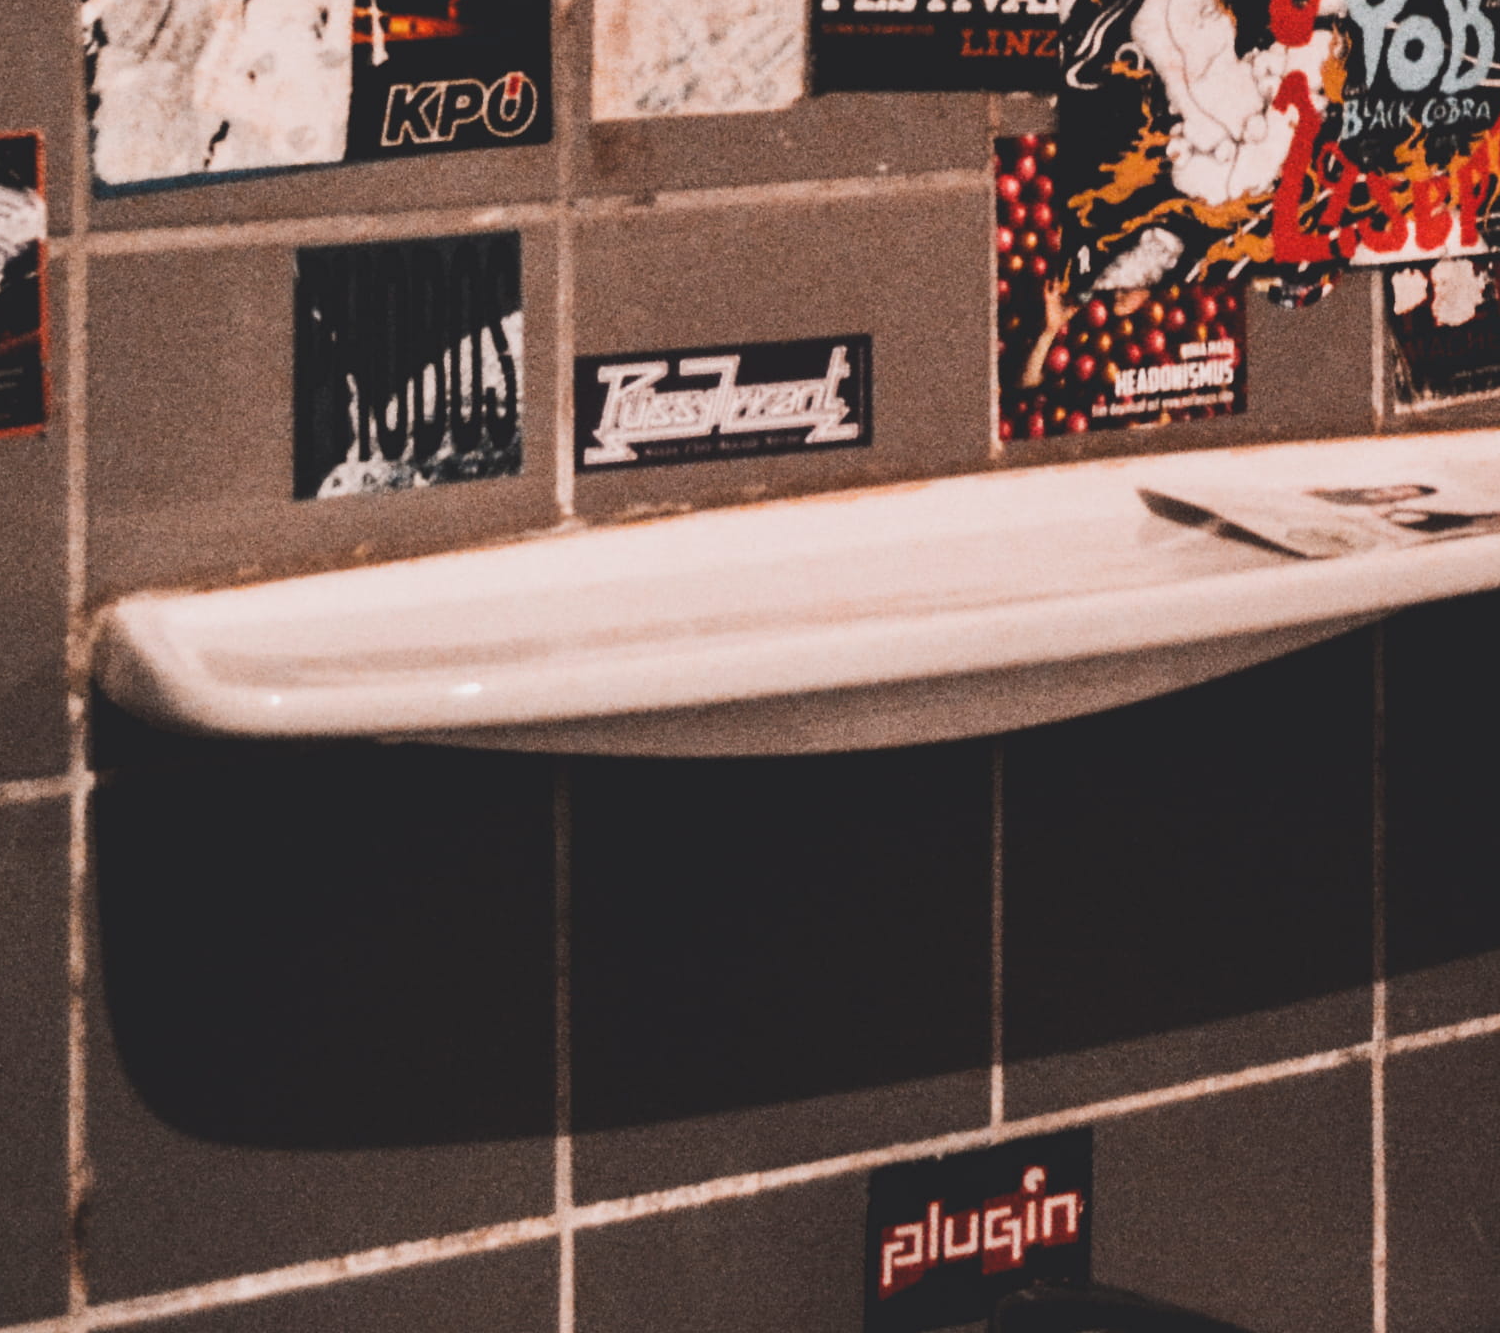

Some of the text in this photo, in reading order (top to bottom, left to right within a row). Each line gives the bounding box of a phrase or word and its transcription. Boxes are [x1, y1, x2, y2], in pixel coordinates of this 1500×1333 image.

[1342, 98, 1491, 139] BLACK COBRA
[1114, 361, 1235, 398] HEADONISMUS
[880, 1165, 1079, 1289] plugin
